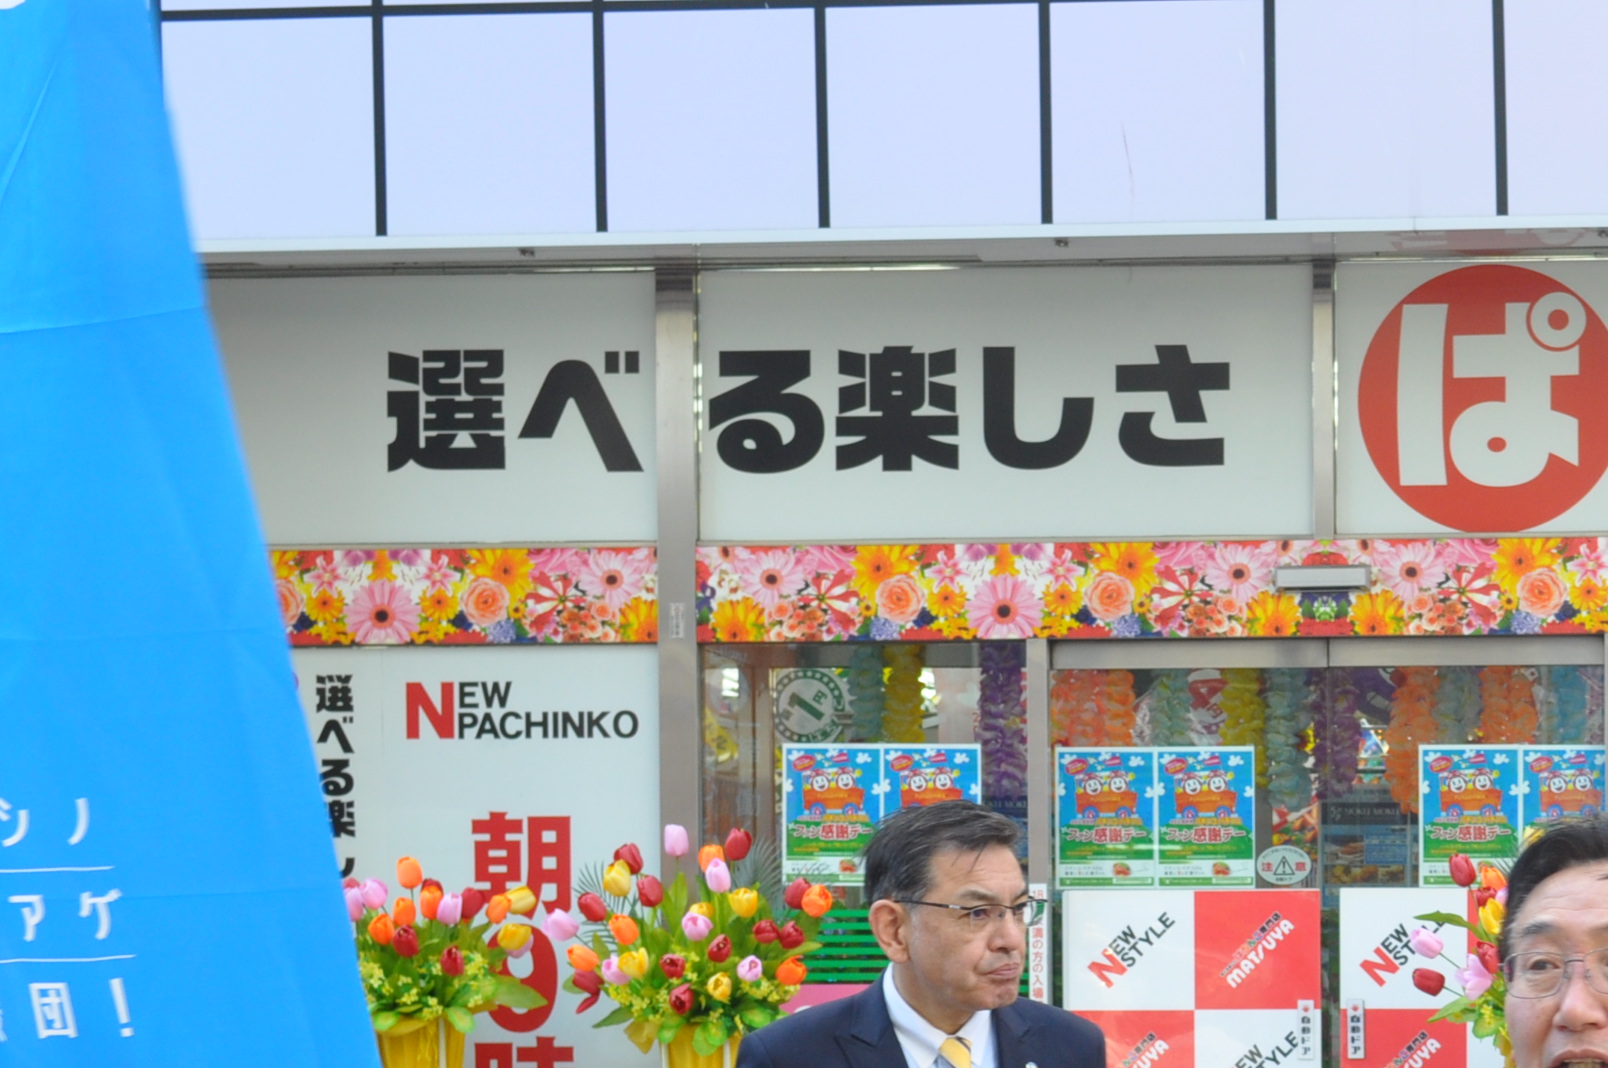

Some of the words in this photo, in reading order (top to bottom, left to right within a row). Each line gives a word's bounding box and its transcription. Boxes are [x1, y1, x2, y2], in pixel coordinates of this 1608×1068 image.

[387, 344, 1231, 474] 選べる楽しさ
[405, 681, 513, 740] NEW
[456, 709, 640, 740] PACHINKO
[1087, 925, 1138, 989] NEW
[1118, 911, 1176, 969] STYLE
[1226, 918, 1296, 990] MATSUYA
[1359, 922, 1410, 988] NEW
[0, 977, 136, 1044] 団!
